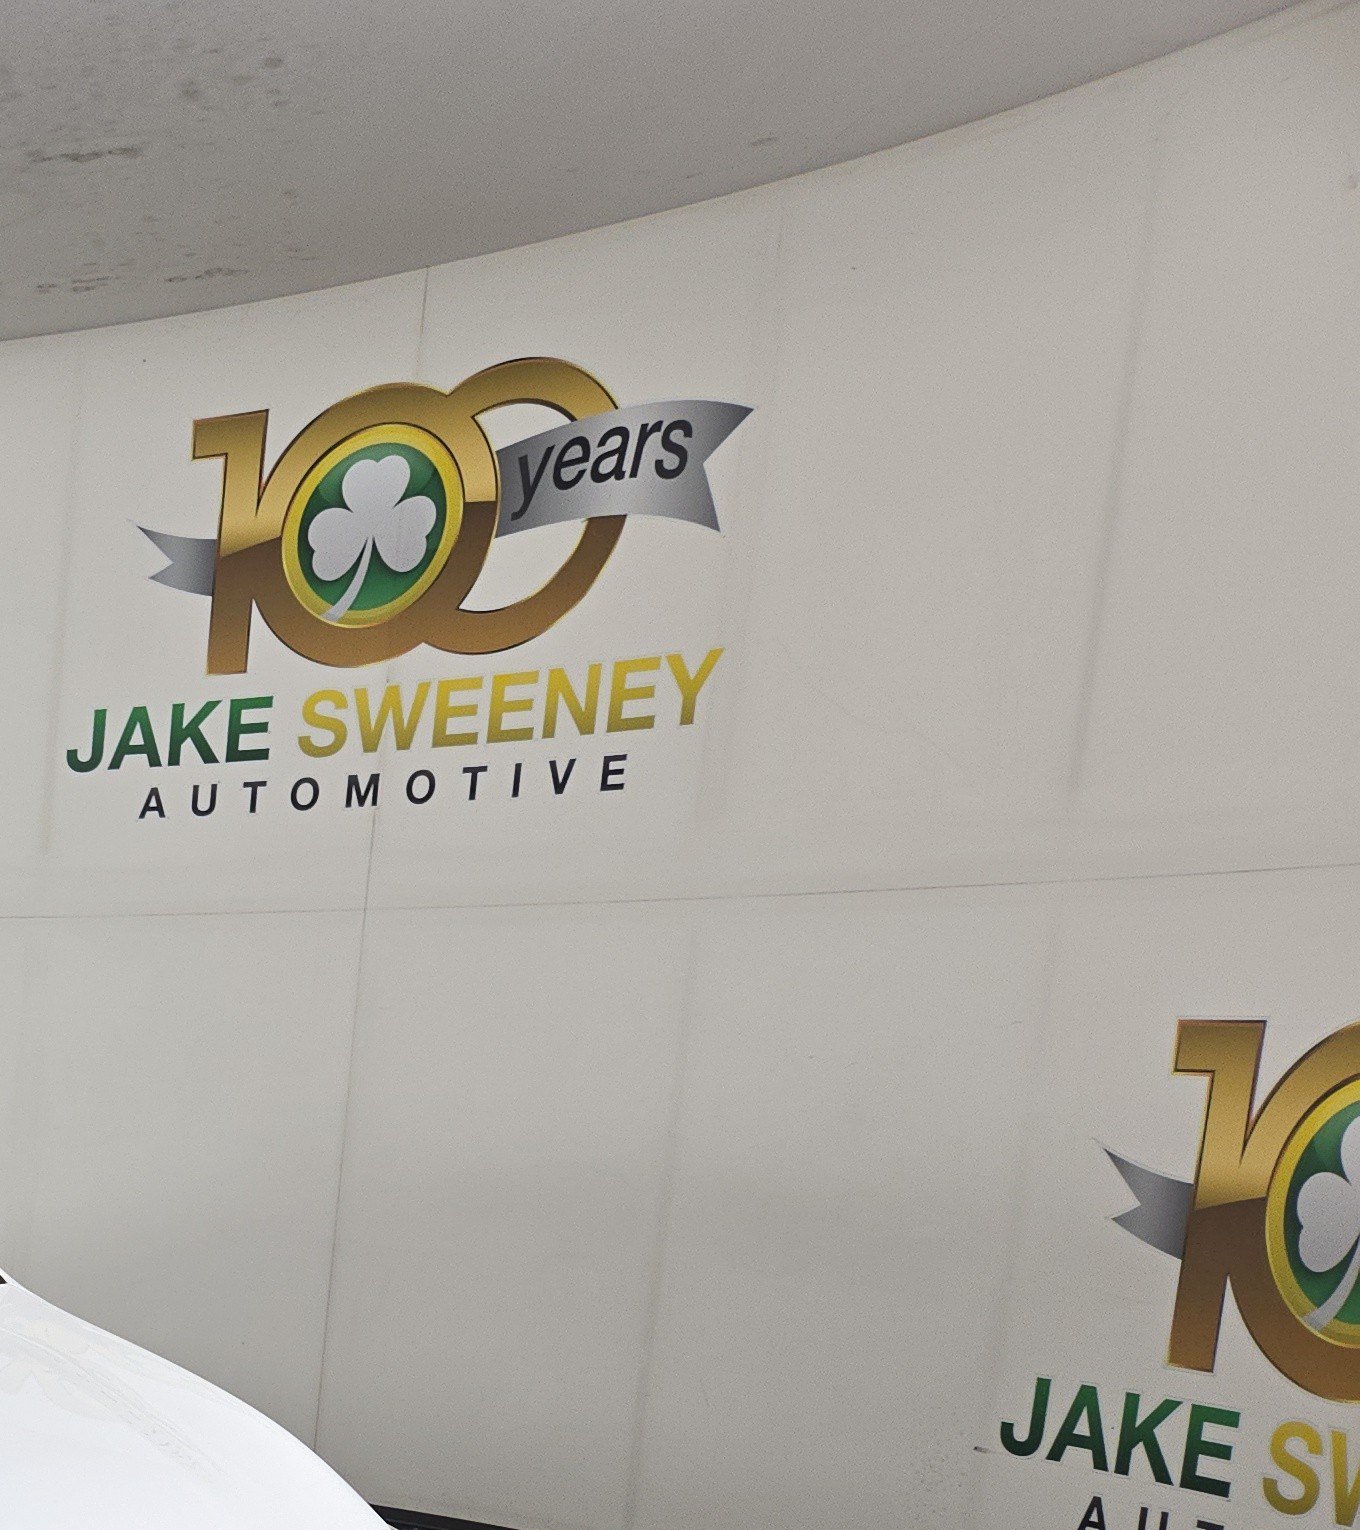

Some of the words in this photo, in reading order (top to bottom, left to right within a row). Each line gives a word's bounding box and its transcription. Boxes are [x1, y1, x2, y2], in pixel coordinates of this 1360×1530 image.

[510, 418, 692, 522] years
[66, 696, 274, 773] JAKE
[296, 648, 725, 758] SWEENEY
[139, 754, 628, 820] AUTOMOTIVE
[1000, 1377, 1241, 1499] JAKE
